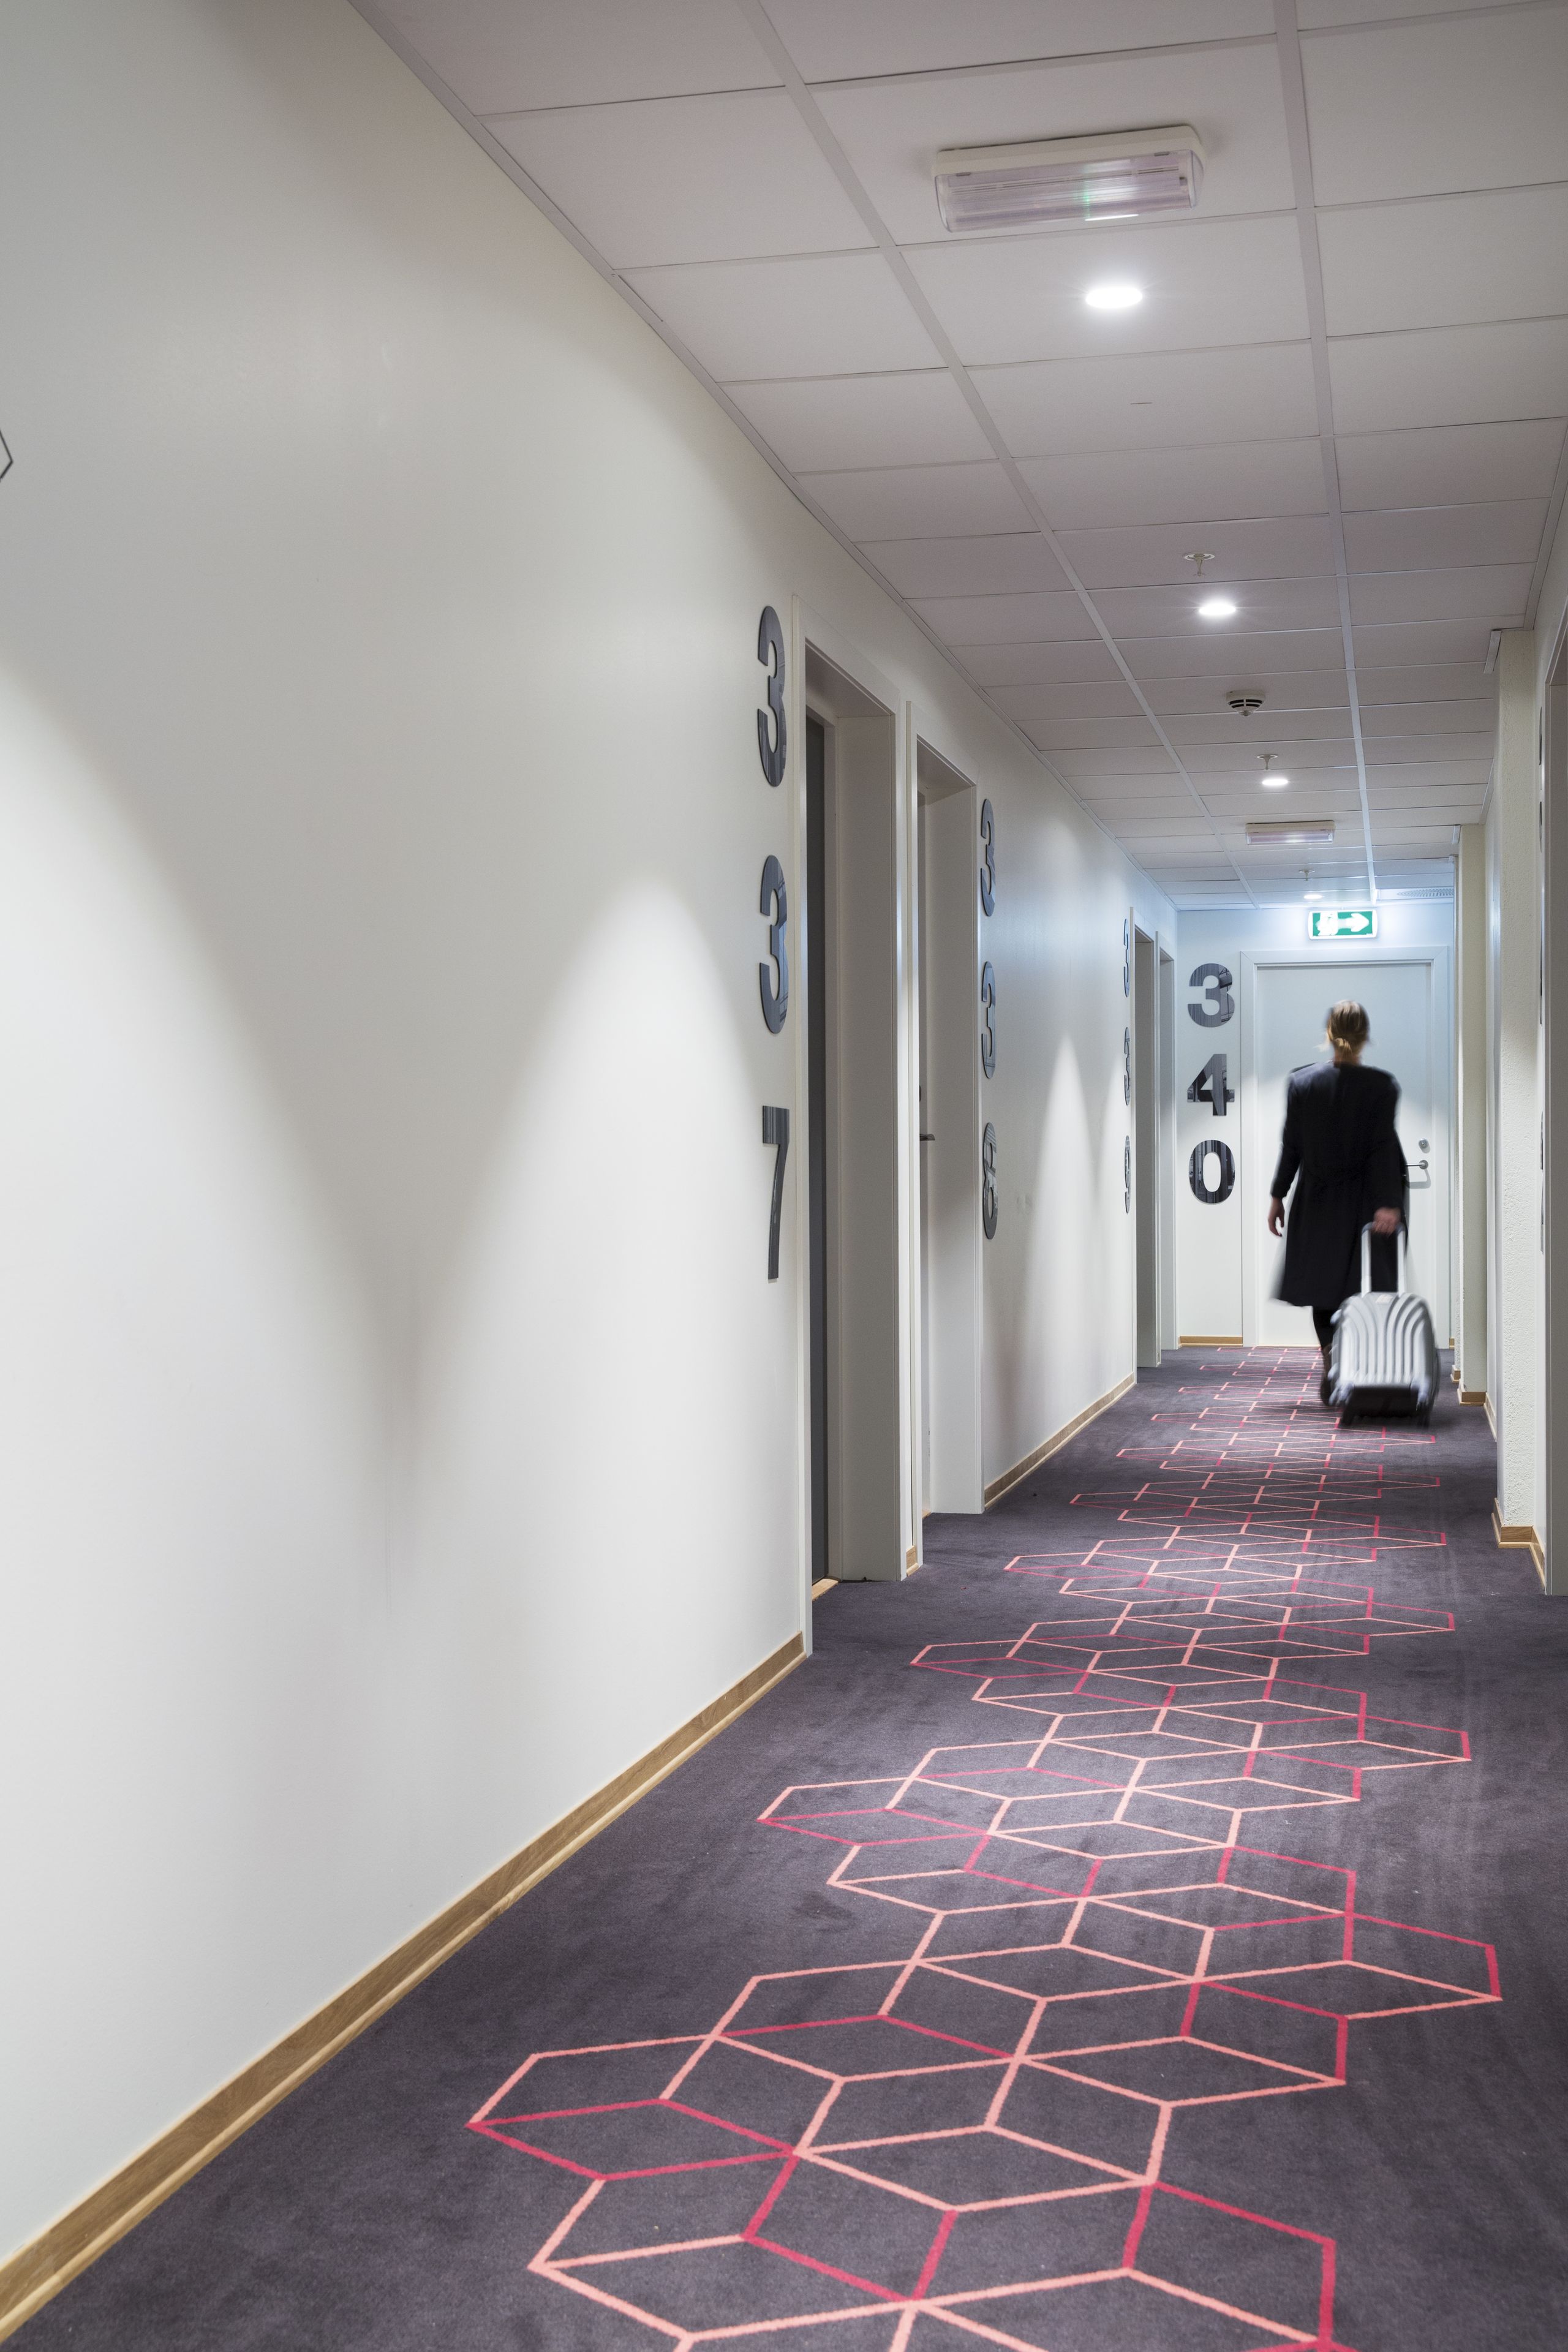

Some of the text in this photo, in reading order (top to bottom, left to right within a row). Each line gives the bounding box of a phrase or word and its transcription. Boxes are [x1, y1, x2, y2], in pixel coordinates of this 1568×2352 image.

[757, 605, 790, 1280] 337
[981, 798, 998, 1239] 338
[1187, 963, 1235, 1204] 340
